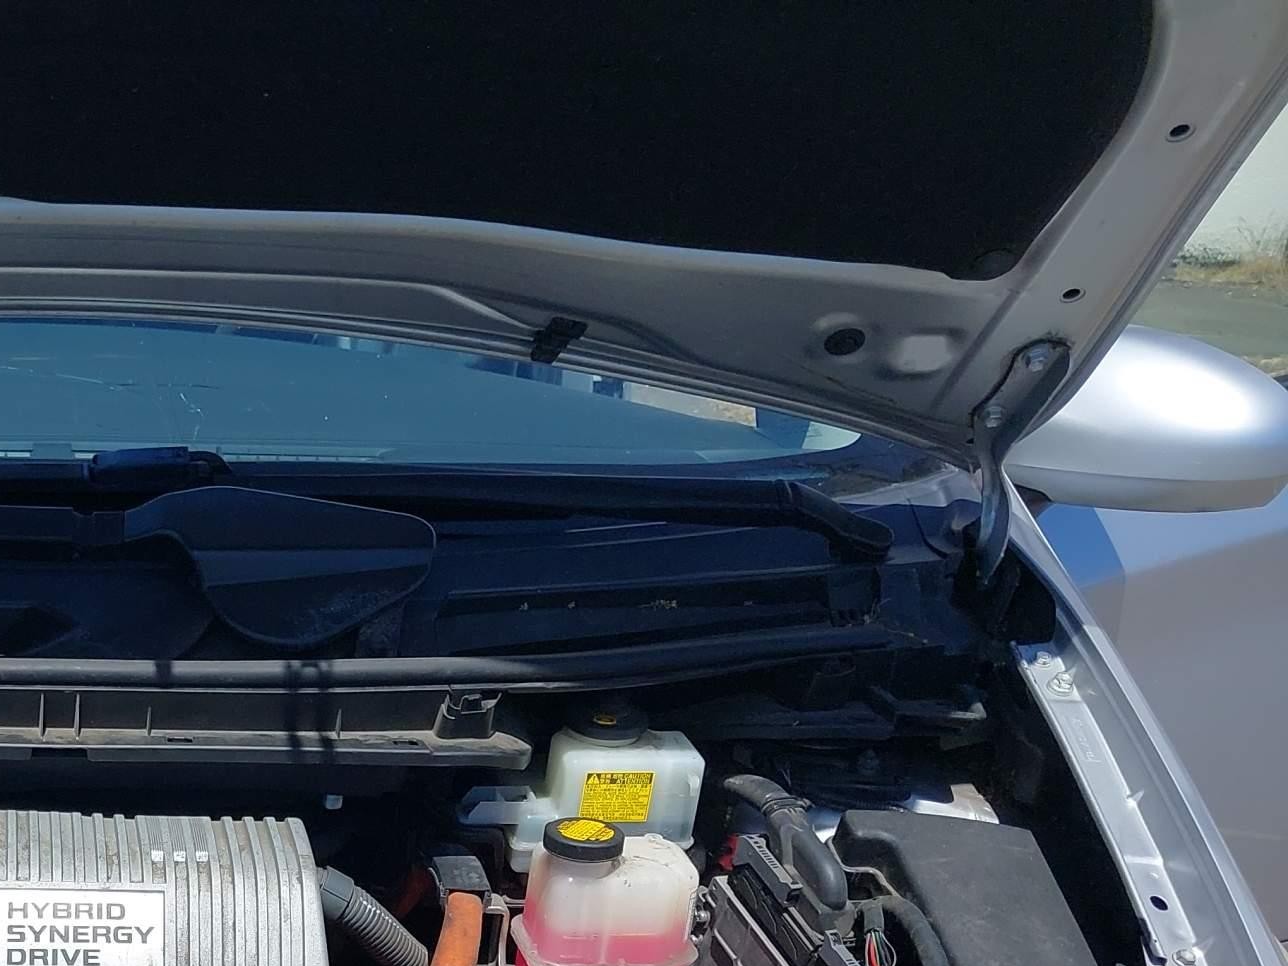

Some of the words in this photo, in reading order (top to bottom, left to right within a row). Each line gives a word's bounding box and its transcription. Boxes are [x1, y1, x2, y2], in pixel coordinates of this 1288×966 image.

[7, 902, 126, 920] HYBRID
[6, 924, 155, 944] SYNERGY
[6, 948, 101, 966] DRIVE
